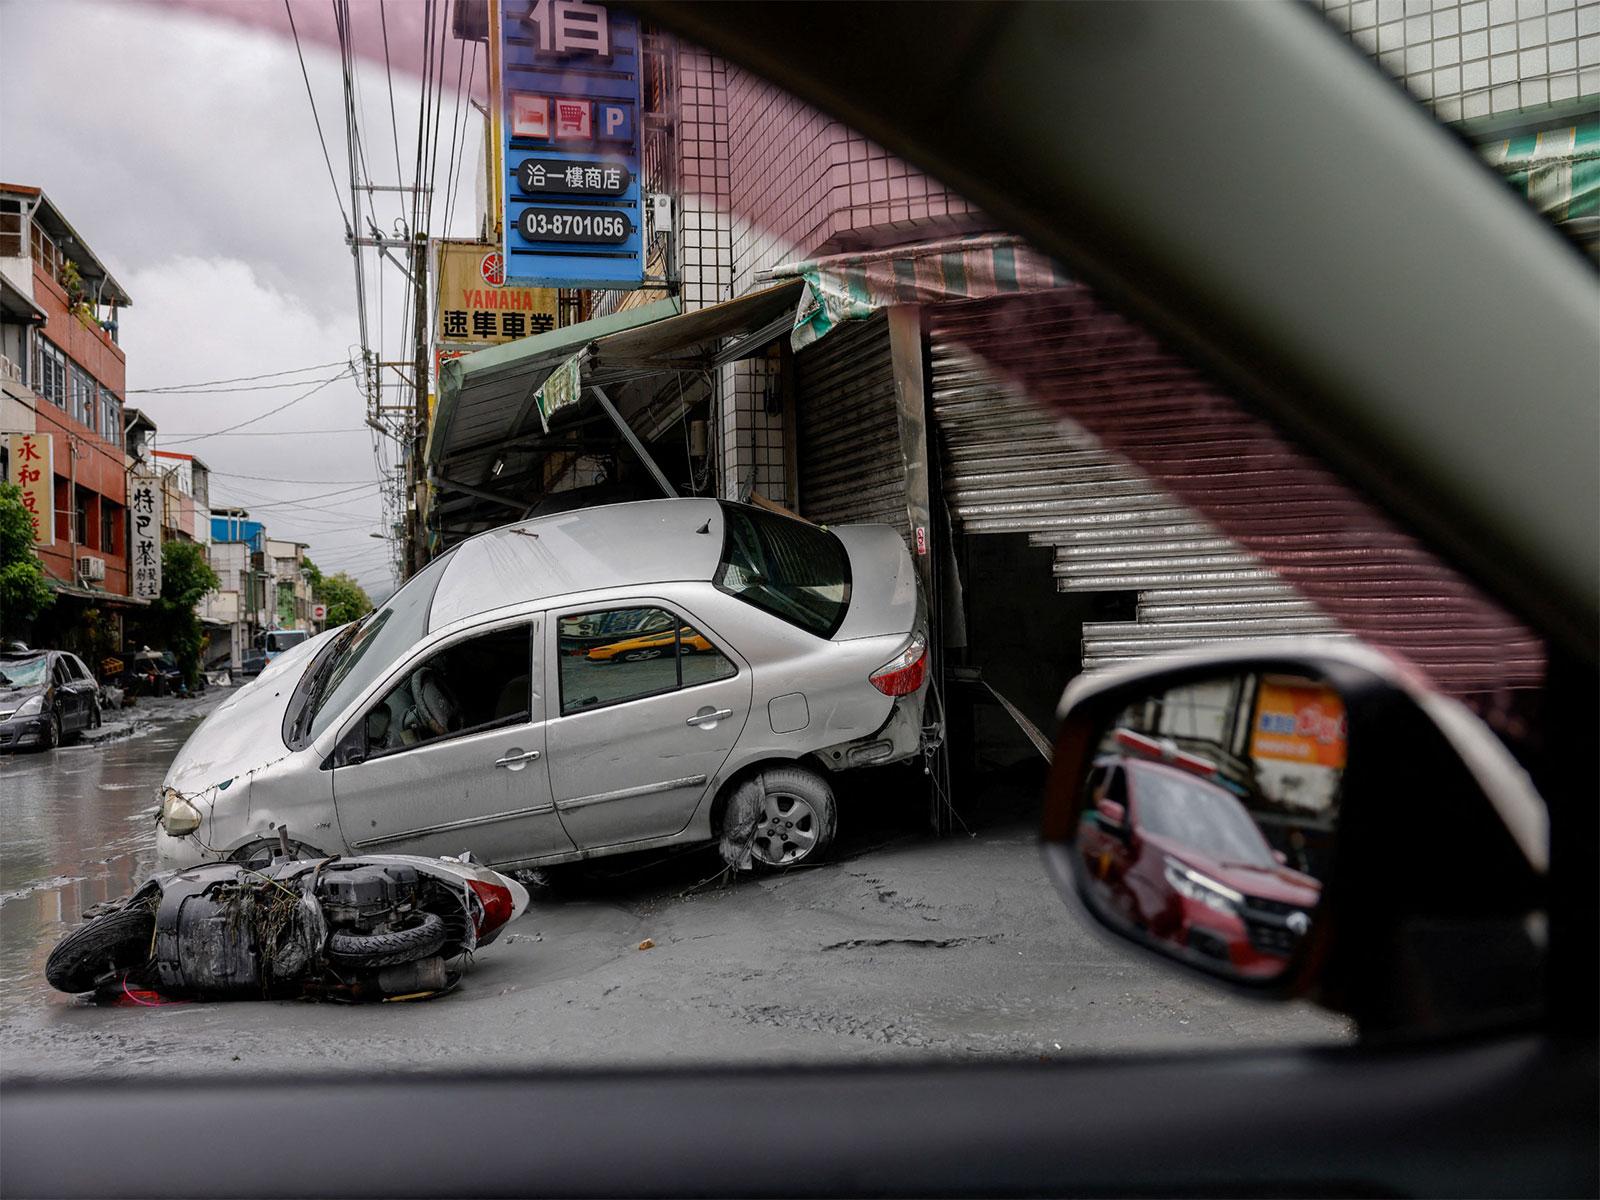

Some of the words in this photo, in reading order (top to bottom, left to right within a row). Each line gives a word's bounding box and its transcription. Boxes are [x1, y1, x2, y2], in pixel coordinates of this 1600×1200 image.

[527, 163, 621, 189] 洽一樓商店
[526, 213, 625, 237] 03-8701056
[463, 289, 533, 311] YAMAHA
[443, 310, 554, 339] 速隼車業
